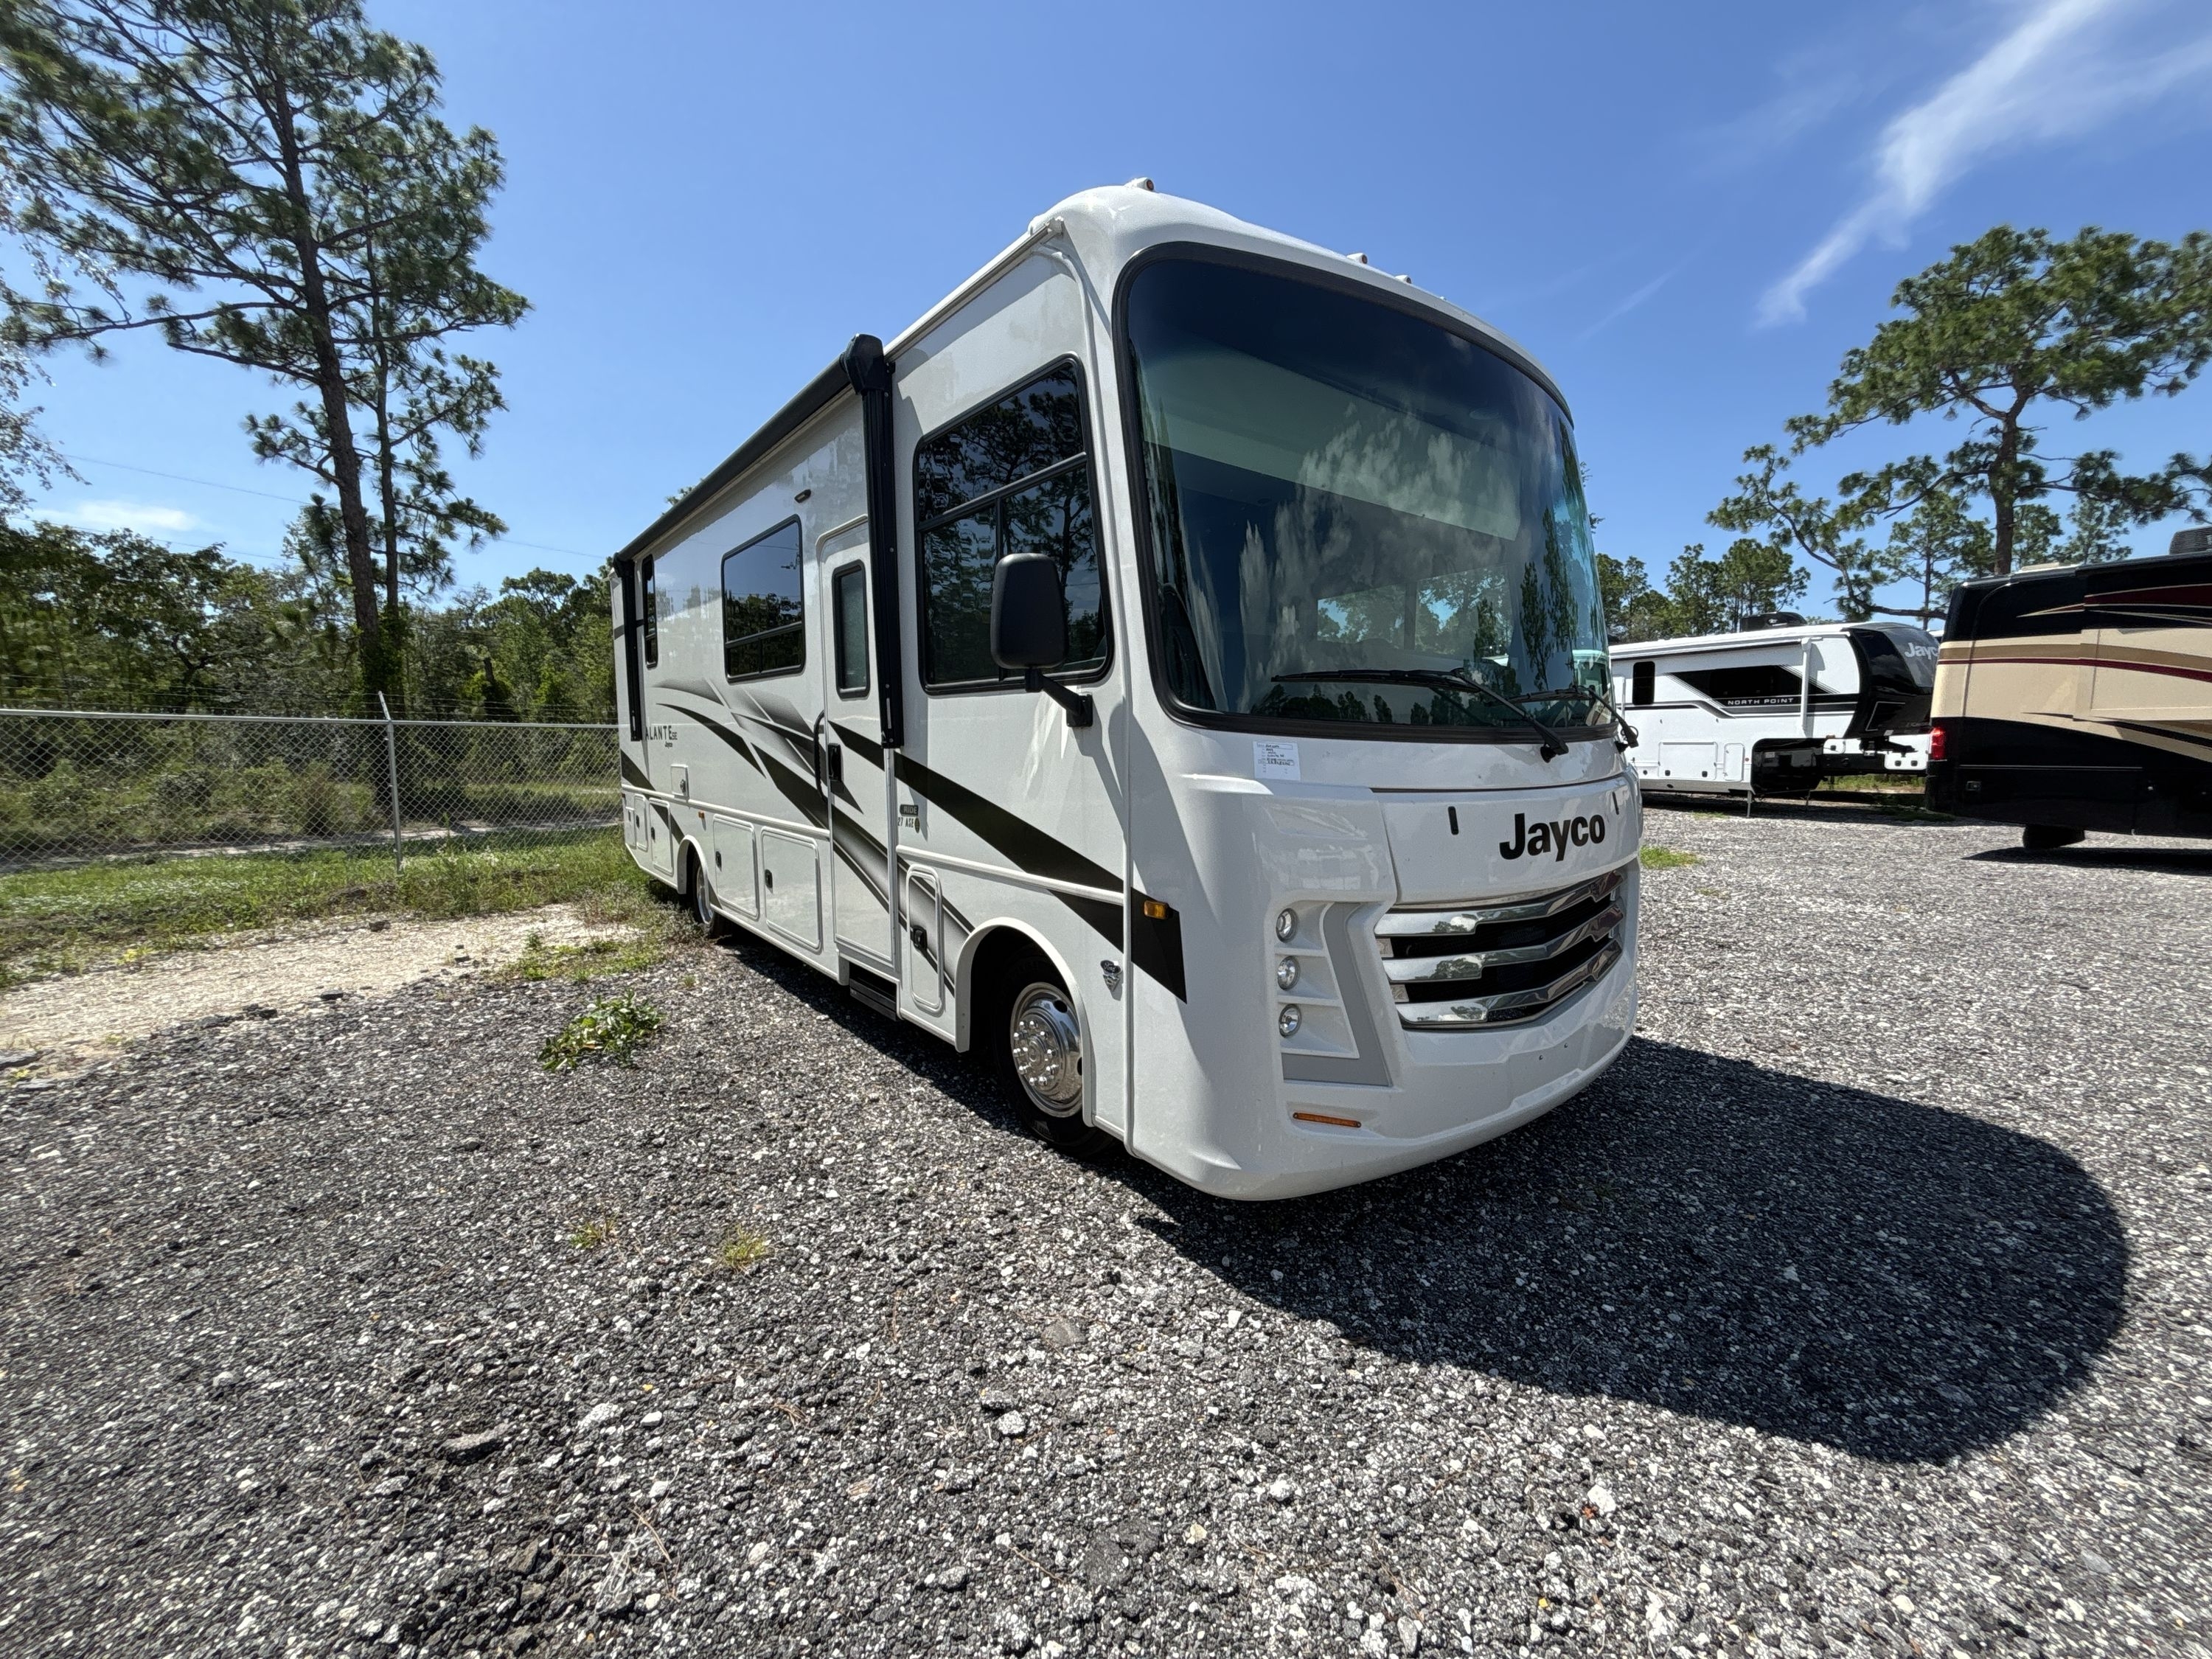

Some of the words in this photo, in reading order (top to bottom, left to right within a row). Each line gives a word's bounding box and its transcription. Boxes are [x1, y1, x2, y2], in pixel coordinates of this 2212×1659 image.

[1905, 642, 1938, 660] Jayc
[645, 726, 672, 740] ALANTE
[1499, 813, 1605, 862] Jayco
